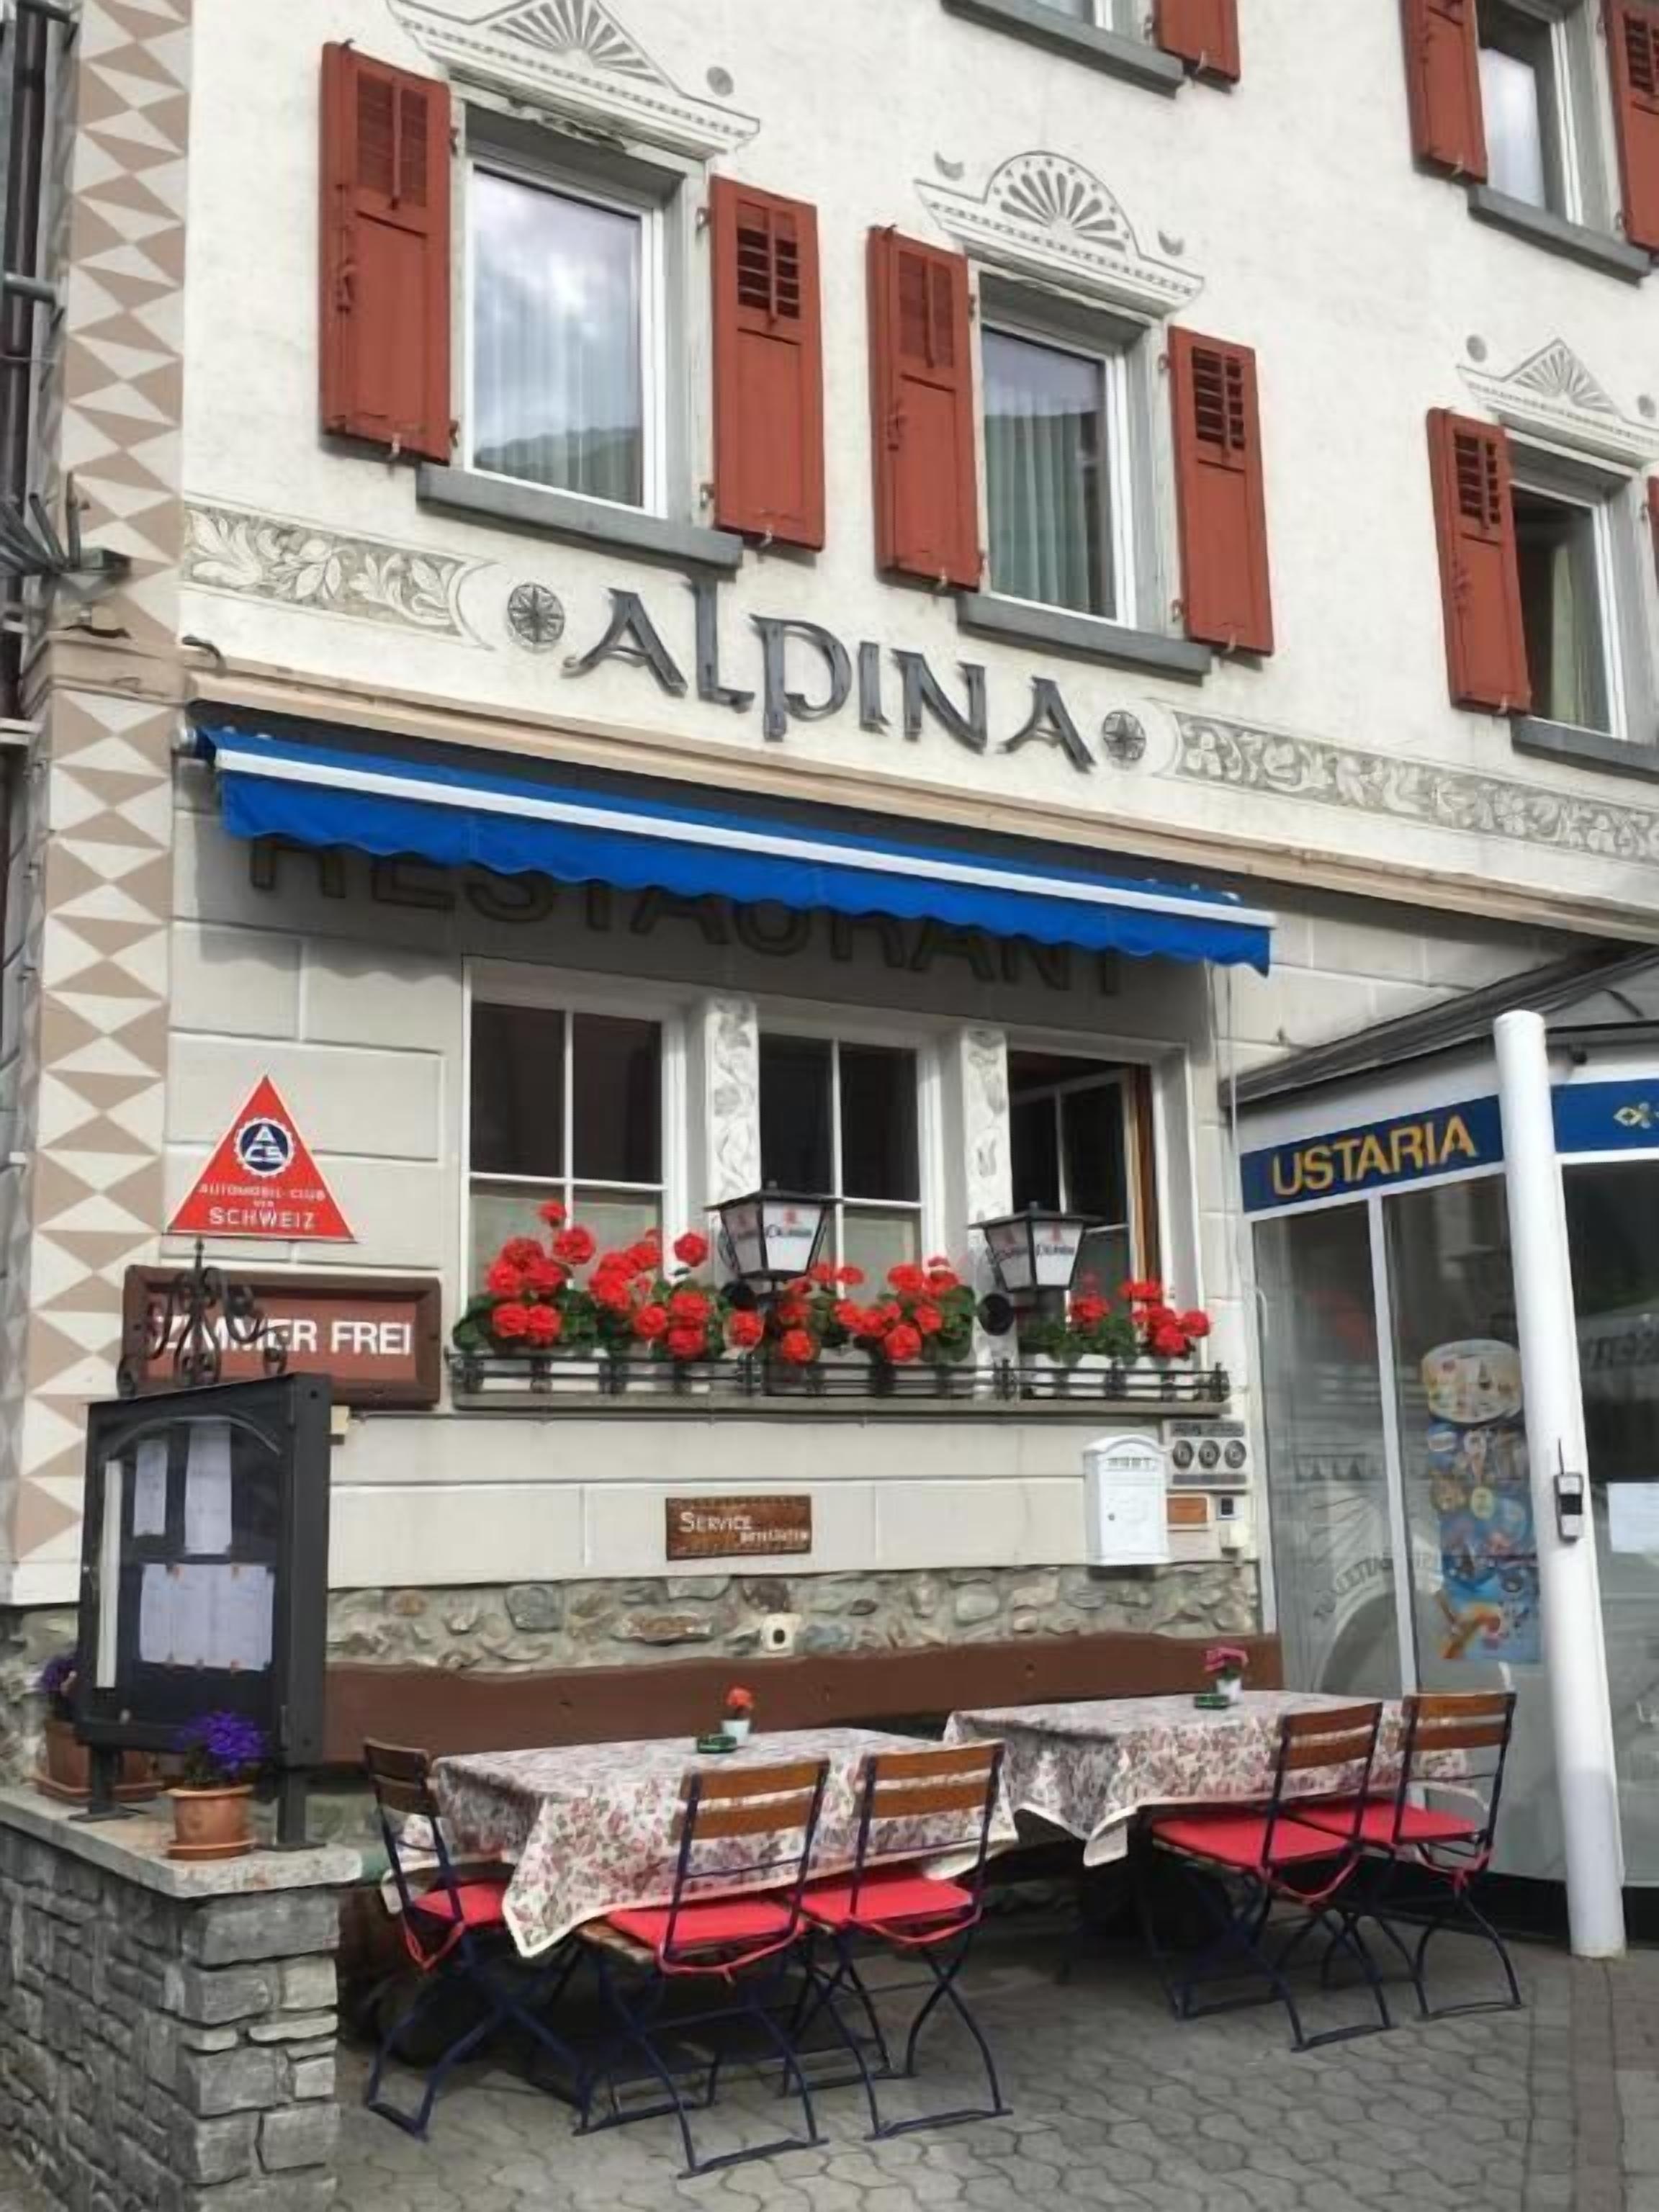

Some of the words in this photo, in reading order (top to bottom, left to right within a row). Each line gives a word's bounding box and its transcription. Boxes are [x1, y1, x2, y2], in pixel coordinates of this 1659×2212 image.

[562, 573, 1098, 774] ALPINA
[1272, 1114, 1478, 1197] USTARIA
[209, 1207, 315, 1229] SCHWEIZ
[330, 1319, 411, 1355] FREI
